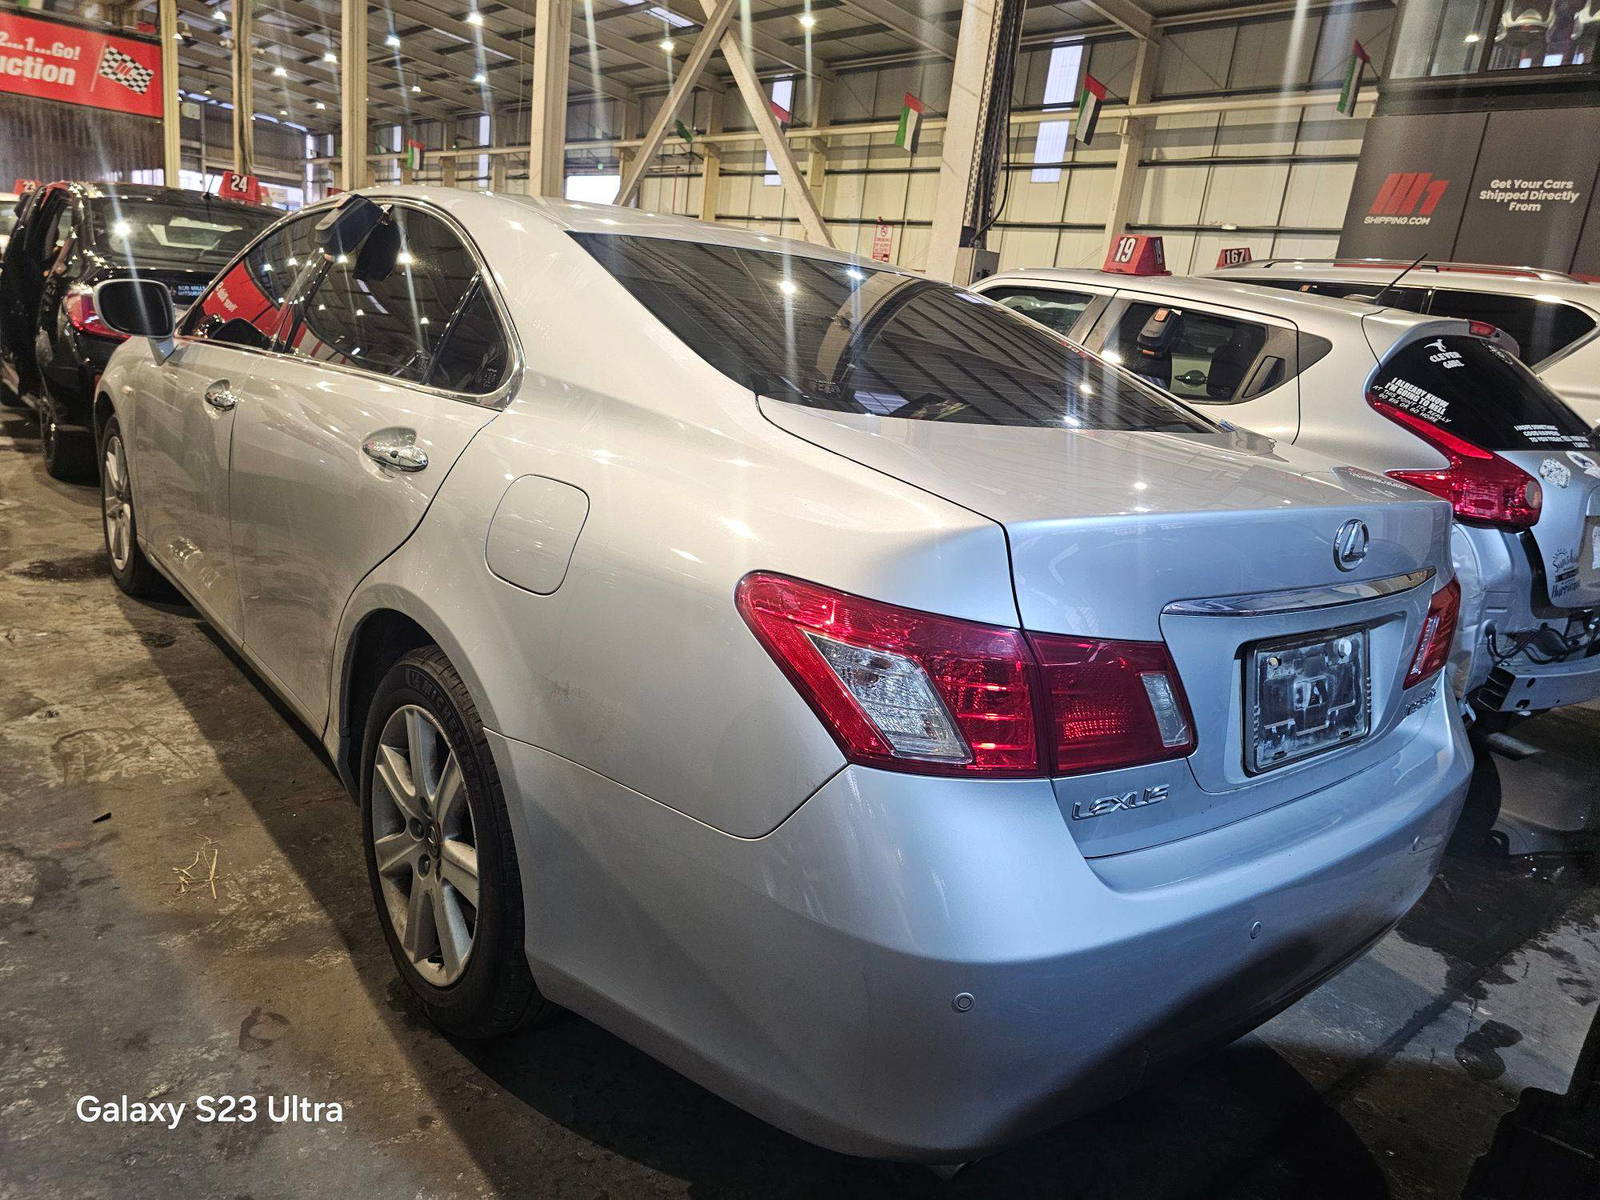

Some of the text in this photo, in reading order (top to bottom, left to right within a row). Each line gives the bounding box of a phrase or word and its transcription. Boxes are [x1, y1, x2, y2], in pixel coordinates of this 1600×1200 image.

[231, 174, 248, 192] 24
[1490, 179, 1574, 189] Get Your Cars
[1480, 190, 1580, 203] Shipped Directly
[1508, 202, 1541, 211] From
[1364, 216, 1431, 225] SHIPPING.COM
[1114, 237, 1136, 263] 19
[1225, 249, 1245, 264] 167
[1429, 351, 1462, 362] CLEVER
[1396, 379, 1427, 397] ALREADY
[1425, 393, 1449, 408] KNOW
[1396, 388, 1420, 402] GOING
[1419, 397, 1430, 407] TO
[1428, 403, 1446, 416] HELL
[1072, 783, 1169, 820] LEXUS
